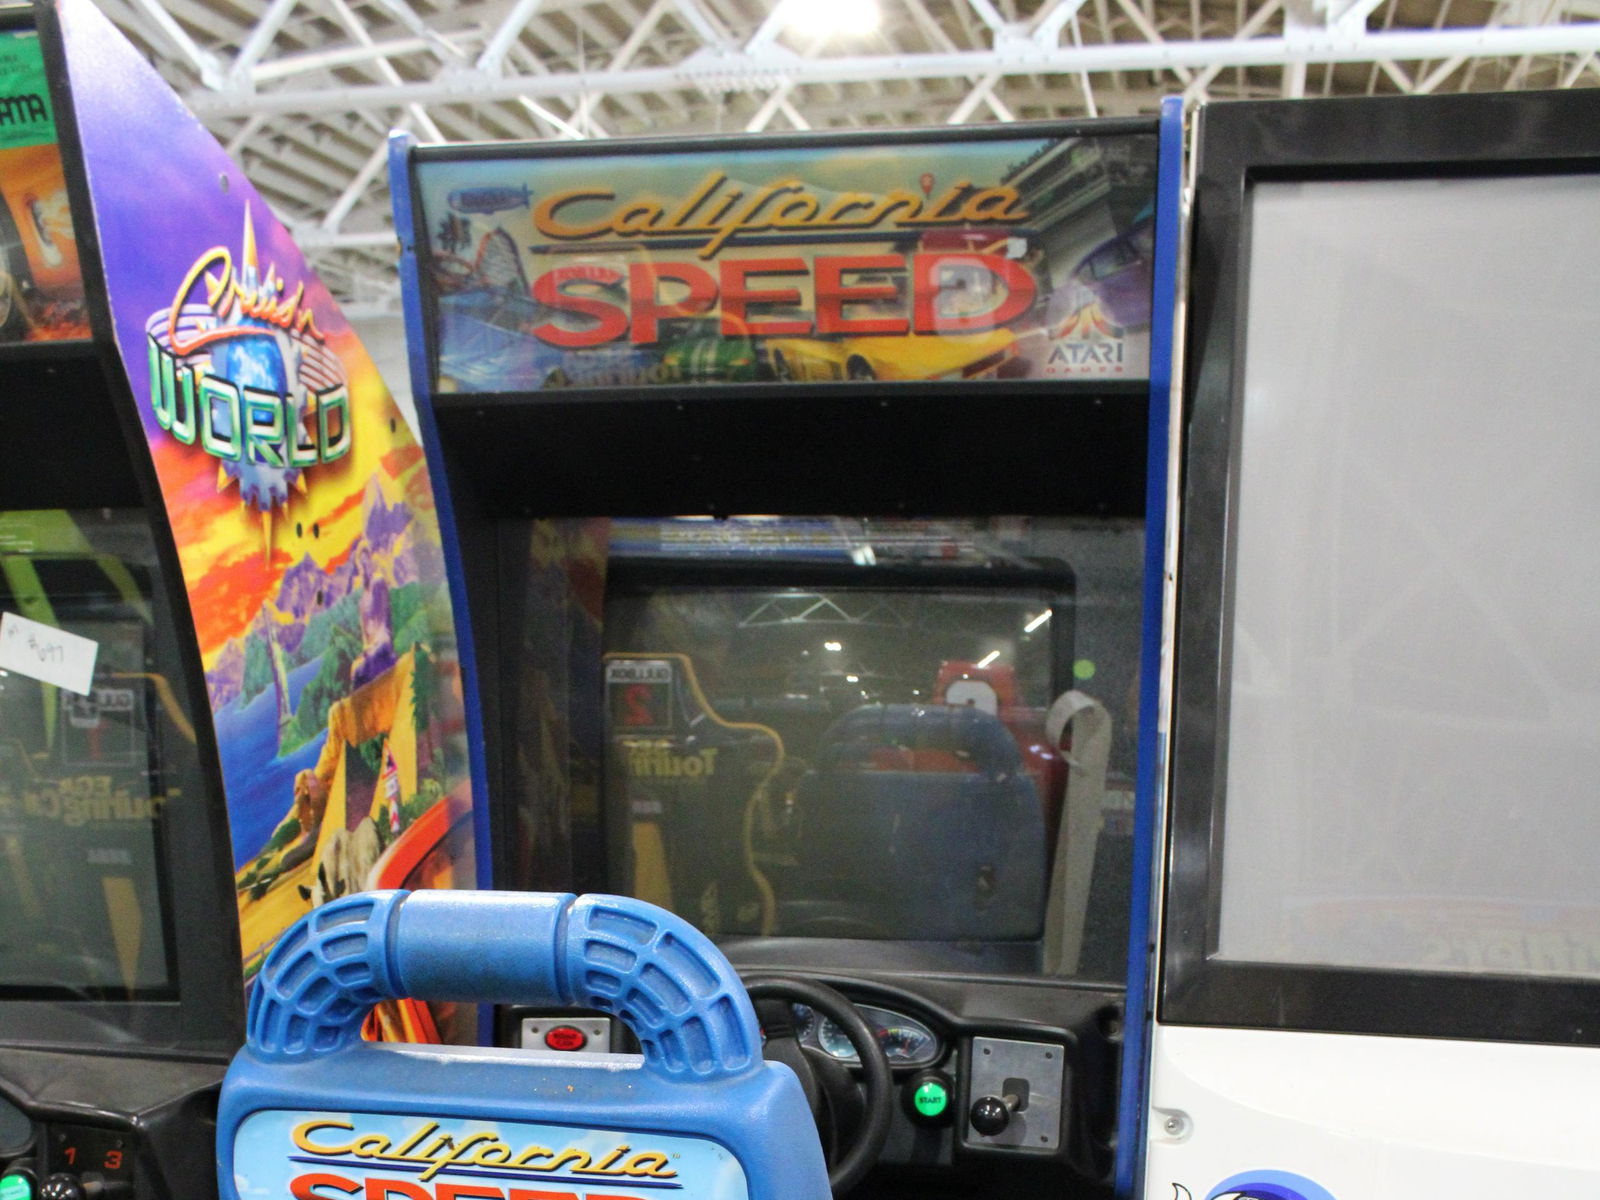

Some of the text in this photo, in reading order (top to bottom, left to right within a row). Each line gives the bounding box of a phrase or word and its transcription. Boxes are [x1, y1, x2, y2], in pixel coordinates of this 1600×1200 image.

[531, 171, 1032, 259] California
[531, 253, 1038, 349] SPEED
[1047, 342, 1124, 365] ATARI
[146, 332, 352, 468] WORLD
[919, 1096, 942, 1105] START
[64, 1147, 123, 1169] 1 3
[291, 1119, 678, 1182] California
